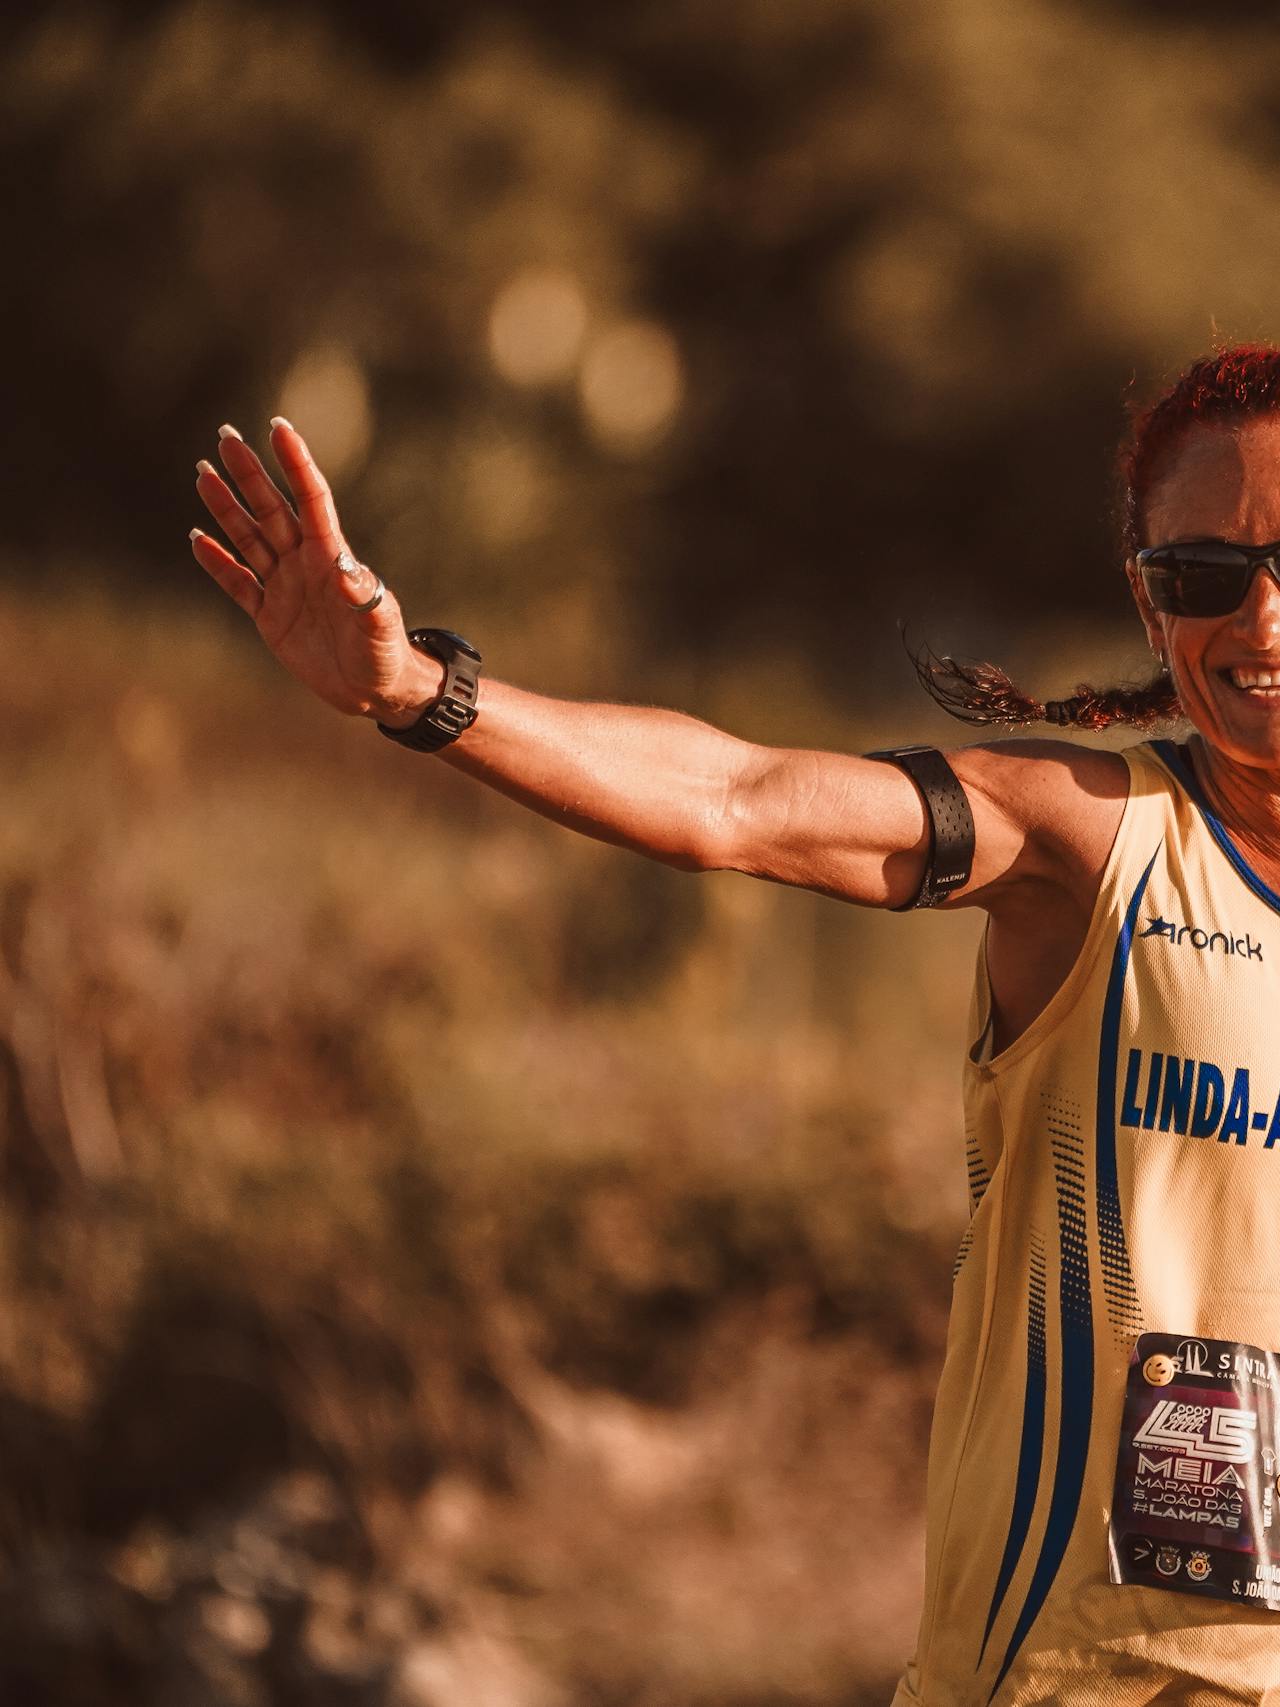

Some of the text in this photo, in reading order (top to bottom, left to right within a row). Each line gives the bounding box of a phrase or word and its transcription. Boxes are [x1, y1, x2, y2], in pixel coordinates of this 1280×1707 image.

[1137, 1452, 1246, 1490] MEIA
[1133, 1488, 1243, 1515] S. JOÃO DAS
[1134, 1475, 1244, 1502] MARATONA
[1132, 1501, 1241, 1530] #LAMPAS
[1231, 1579, 1242, 1595] S.
